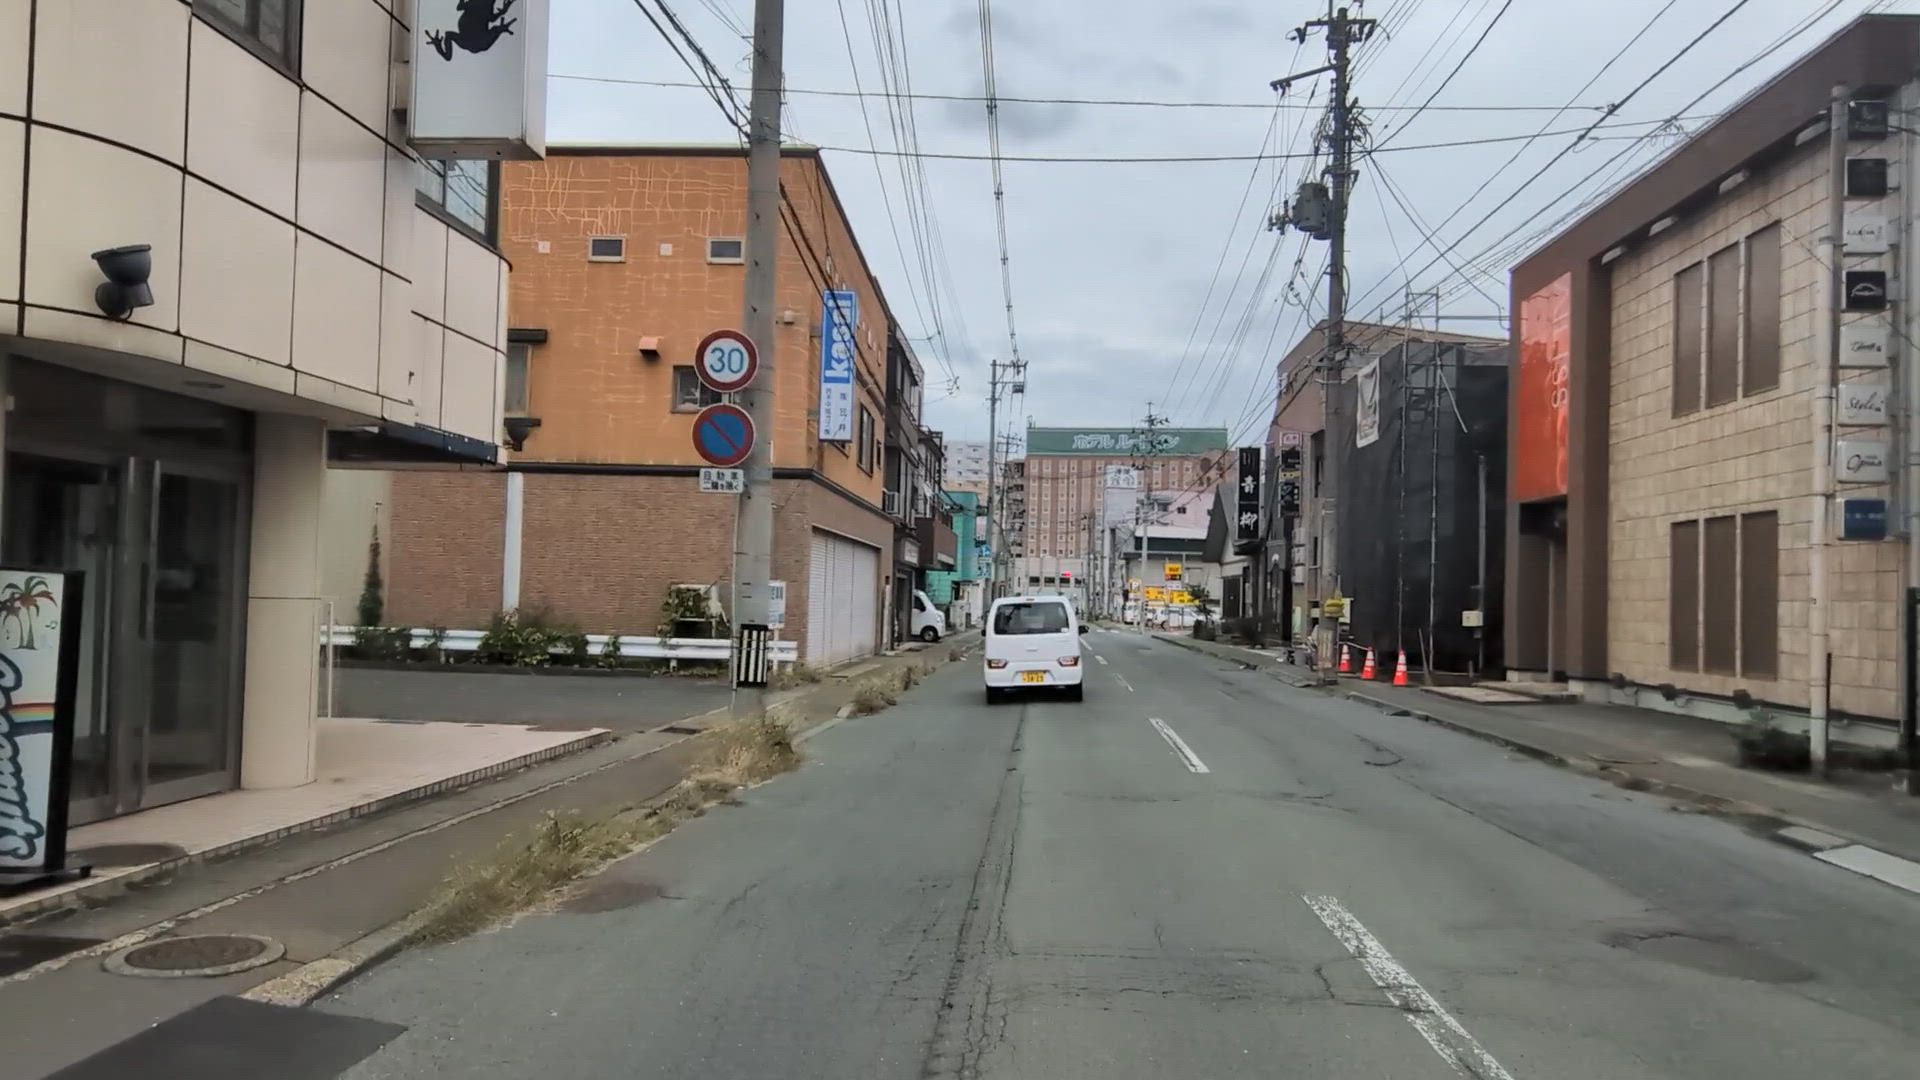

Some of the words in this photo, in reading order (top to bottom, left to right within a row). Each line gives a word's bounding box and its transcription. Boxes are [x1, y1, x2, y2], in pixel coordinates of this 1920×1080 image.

[709, 347, 744, 374] 30
[1072, 433, 1115, 449] ホテル
